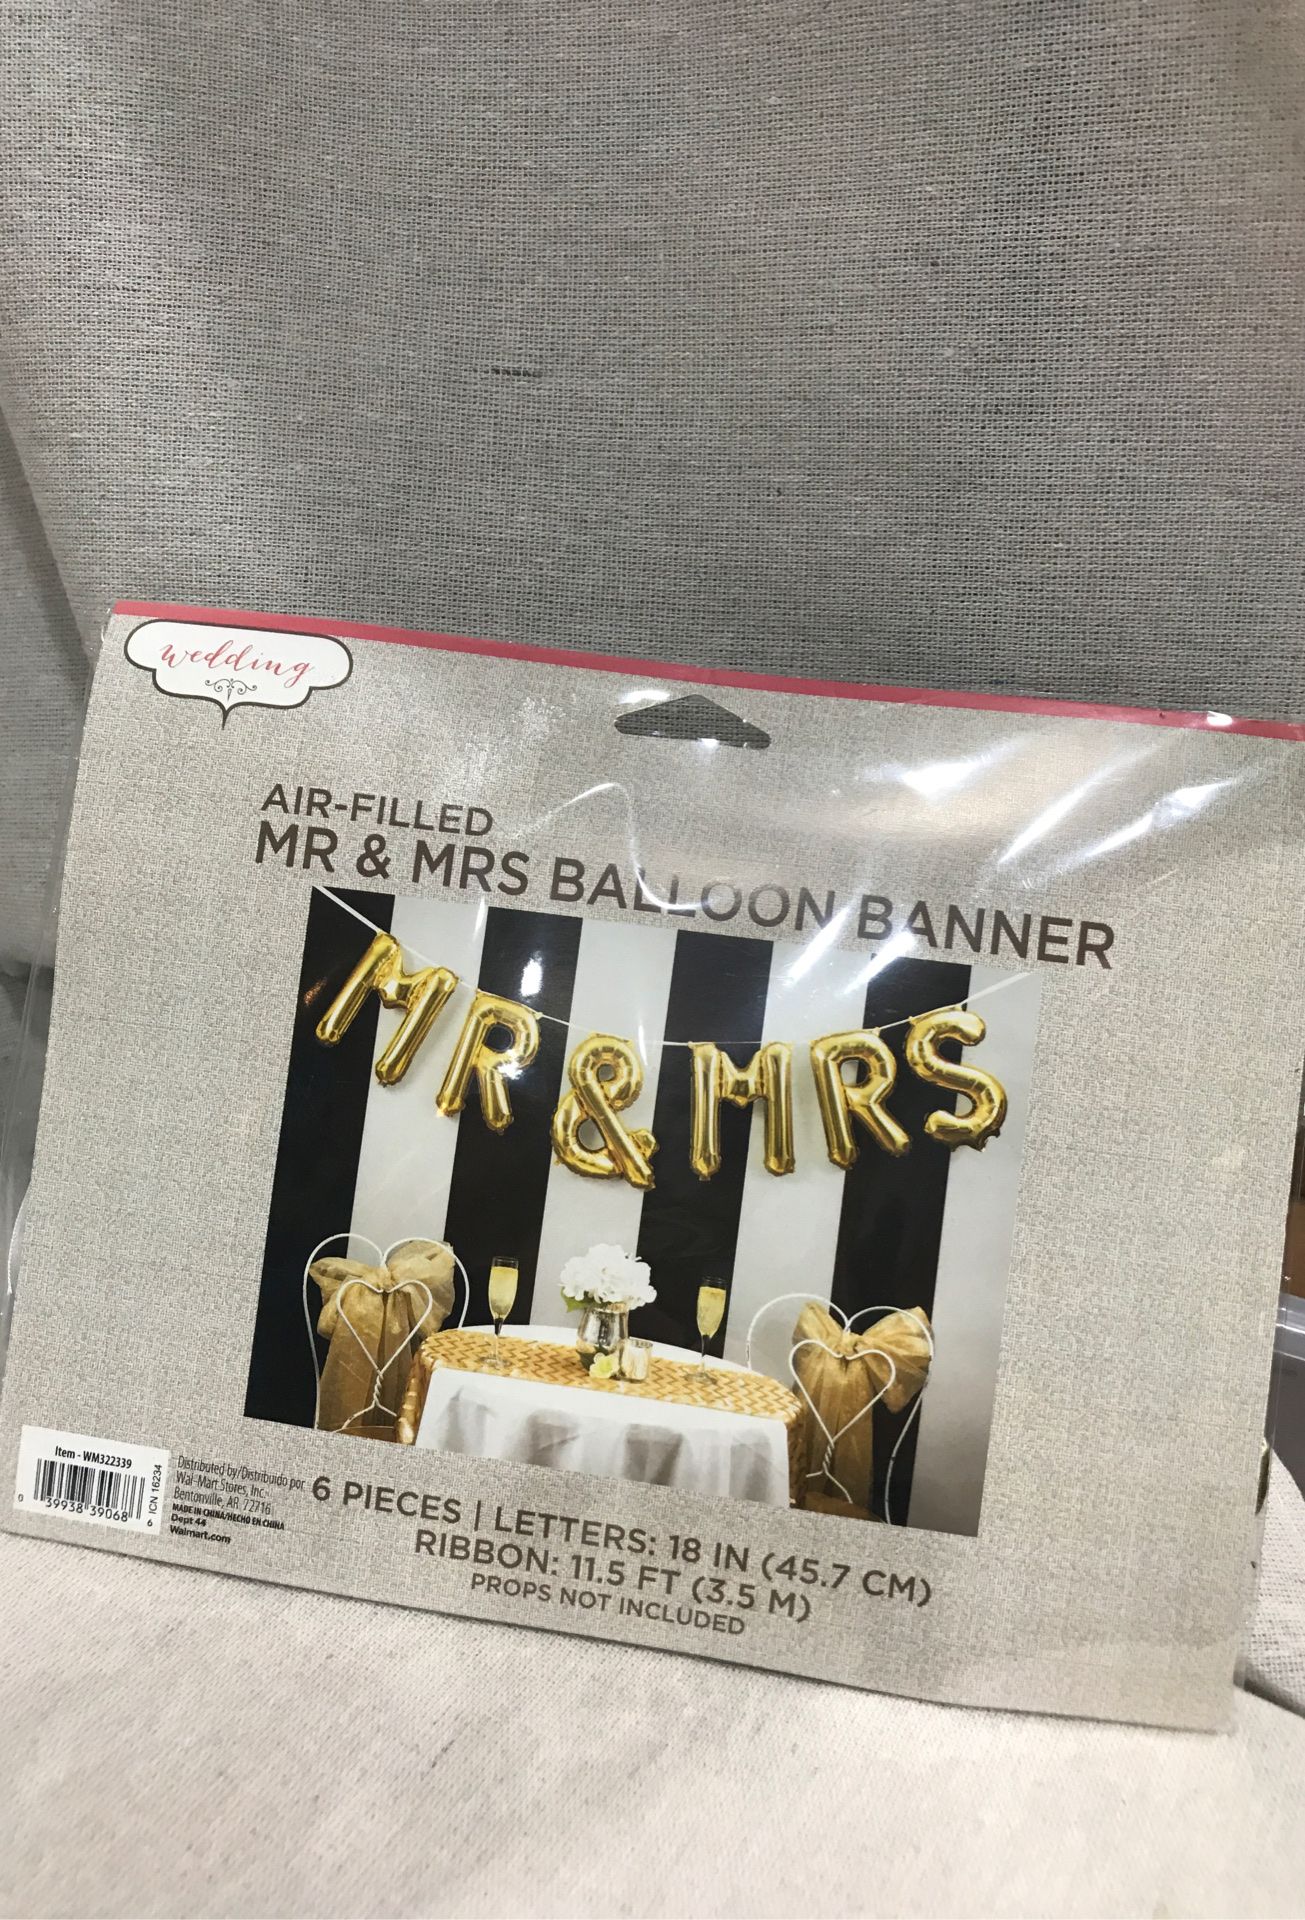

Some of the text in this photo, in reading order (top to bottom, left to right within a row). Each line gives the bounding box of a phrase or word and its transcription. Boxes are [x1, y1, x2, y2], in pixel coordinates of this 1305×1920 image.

[159, 640, 313, 688] wedding
[261, 783, 493, 836] AIR-FILLED
[255, 820, 1114, 969] MR & MRS BALLOON BANNER
[316, 933, 541, 1134] MR
[689, 1006, 1008, 1179] MRS
[55, 1446, 75, 1459] Item
[83, 1451, 132, 1469] WM322339
[177, 1455, 305, 1490] Distributed by/Distribuido por
[149, 1464, 162, 1514] ICN 16234
[173, 1486, 271, 1515] Bentonville, AR 72716
[176, 1470, 266, 1499] Wal-Mart Stores, Inc.
[90, 1505, 128, 1522] 39068
[147, 1518, 153, 1527] 6
[170, 1525, 231, 1544] Walmart.com
[171, 1513, 207, 1527] Dept 44
[172, 1503, 193, 1514] MADE
[194, 1507, 202, 1516] IN
[203, 1508, 250, 1525] CHINA/HECHO
[262, 1518, 285, 1531] CHINA
[312, 1476, 331, 1501] 6
[343, 1481, 462, 1524] PIECES
[495, 1506, 656, 1555] LETTERS:
[669, 1535, 702, 1564] 18
[713, 1542, 749, 1572] IN
[761, 1552, 850, 1589] (45.7
[862, 1570, 931, 1607] CM)
[415, 1529, 811, 1623] RIBBON: 11.5 FT (3.5 M)
[471, 1573, 745, 1635] PROPS NOT INCLUDED
